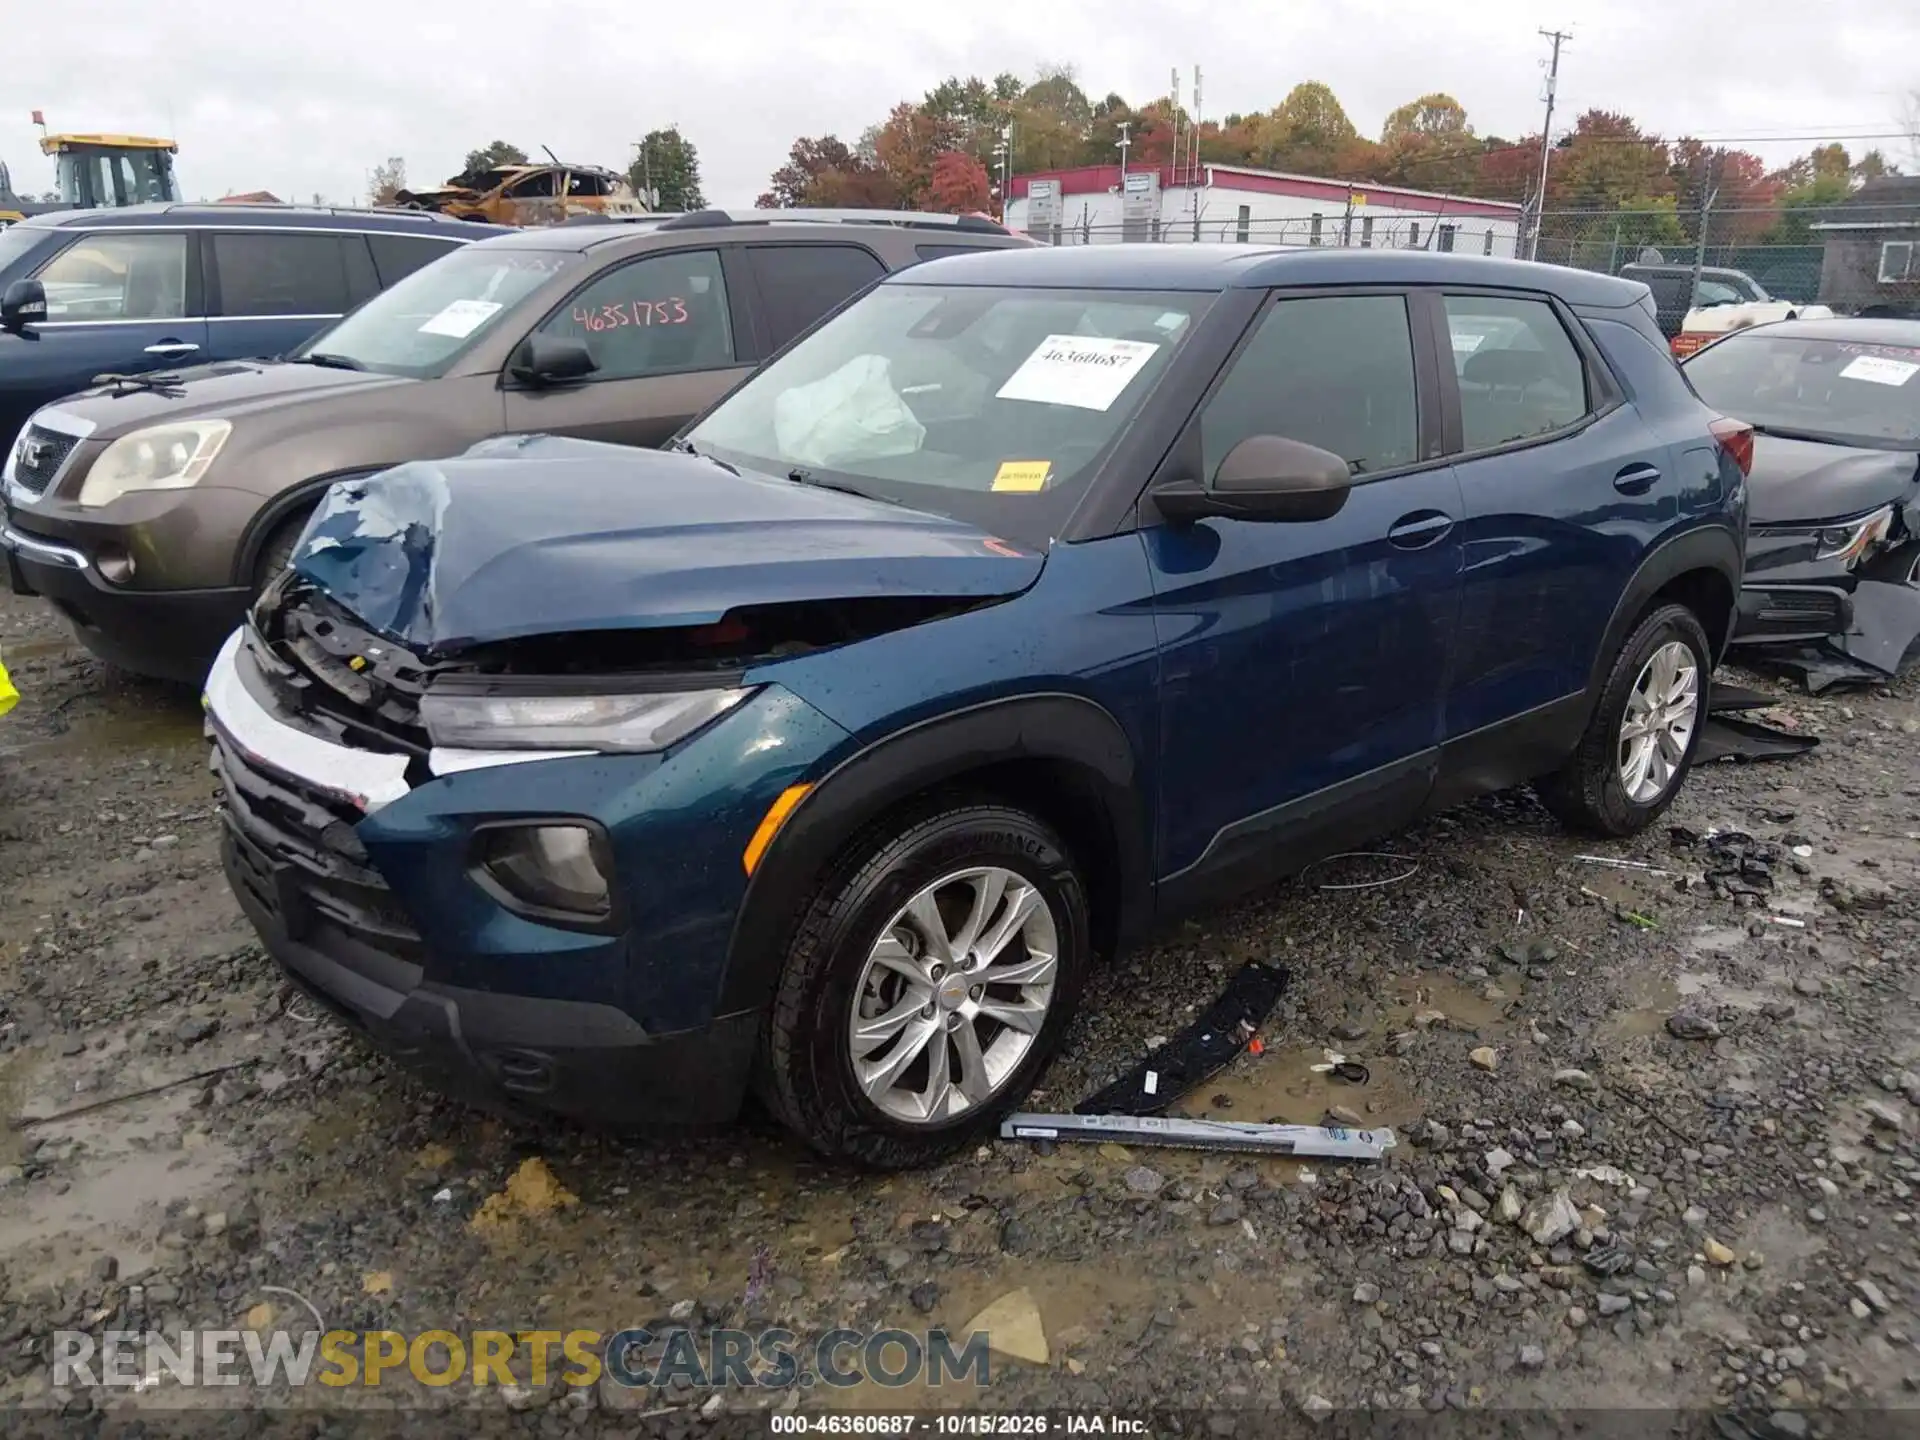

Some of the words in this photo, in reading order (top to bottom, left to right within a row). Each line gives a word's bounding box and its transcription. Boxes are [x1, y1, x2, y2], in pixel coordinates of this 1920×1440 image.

[572, 297, 689, 333] 46351753
[1041, 349, 1133, 369] 46360687
[17, 436, 41, 469] MC
